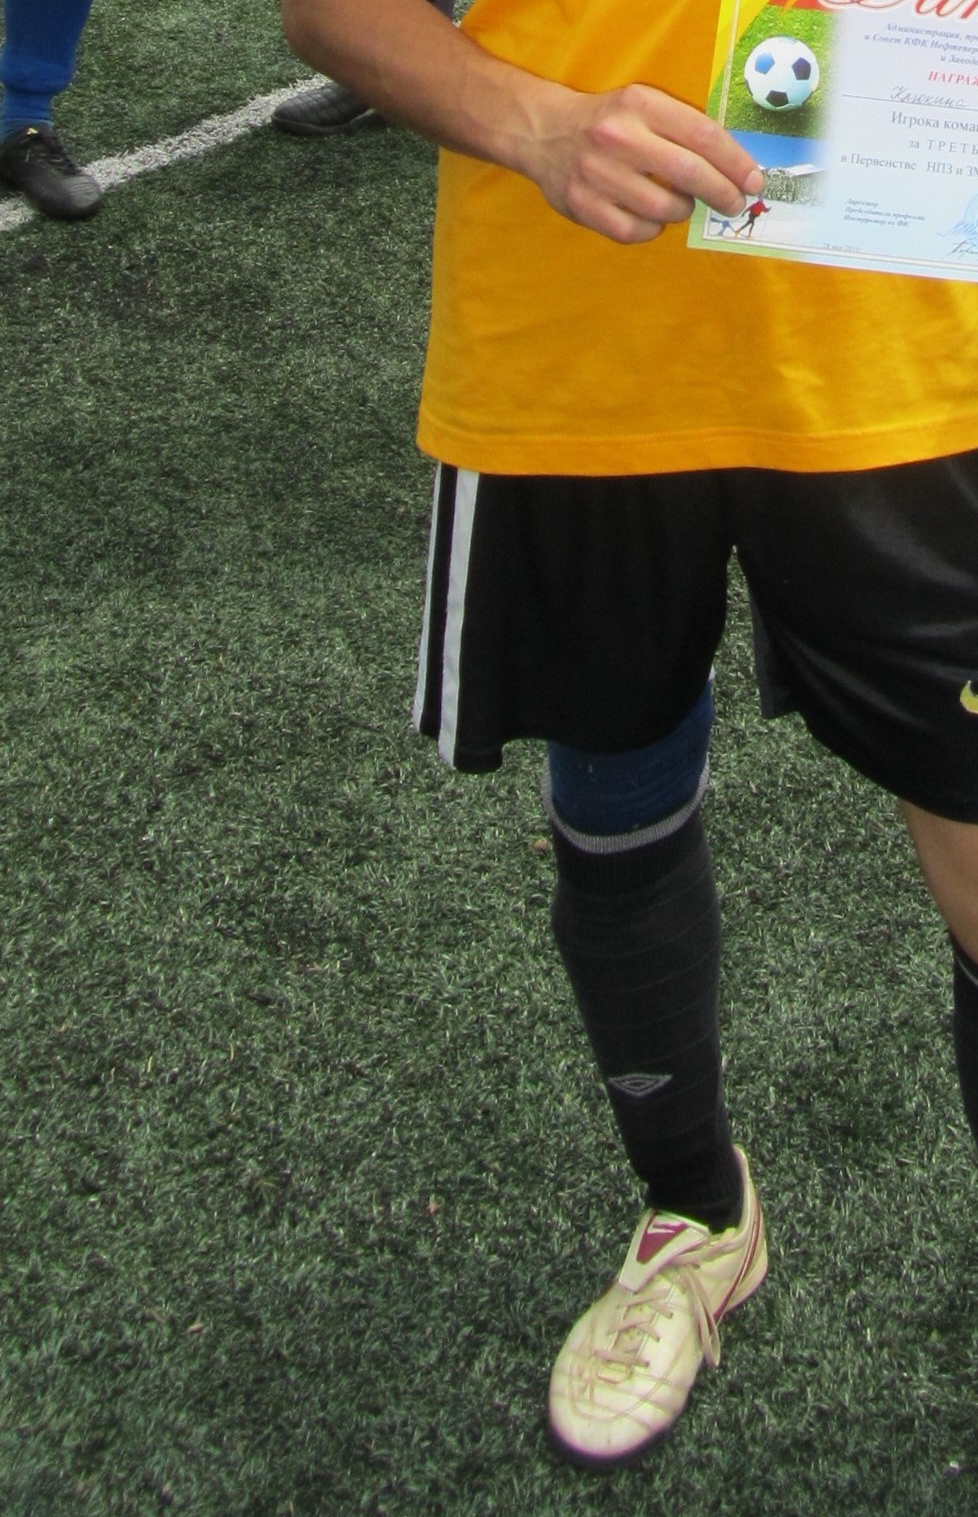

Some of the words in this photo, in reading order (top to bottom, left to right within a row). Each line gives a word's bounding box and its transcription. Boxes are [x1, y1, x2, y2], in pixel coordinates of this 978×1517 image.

[873, 33, 901, 44] Совет
[904, 37, 928, 49] КФК
[891, 111, 940, 130] Игрока
[908, 140, 920, 150] за
[841, 154, 847, 163] в
[850, 153, 917, 171] Первенстве
[926, 161, 953, 174] НПЗ
[956, 166, 963, 175] и
